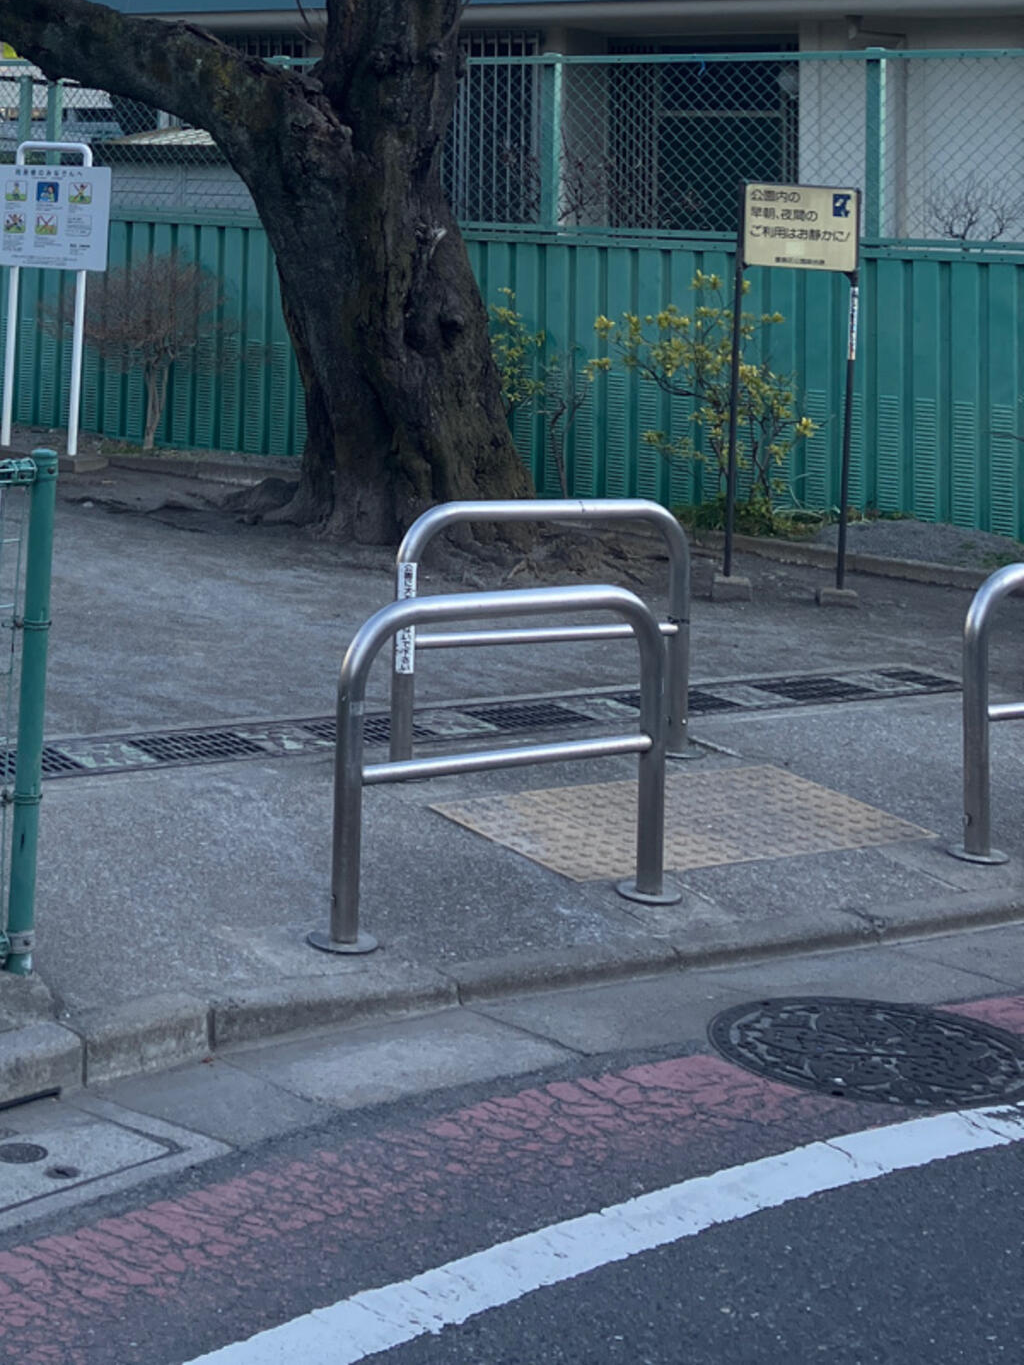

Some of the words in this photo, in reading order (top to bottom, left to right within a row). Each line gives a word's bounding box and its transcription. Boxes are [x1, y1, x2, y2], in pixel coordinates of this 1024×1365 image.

[750, 189, 800, 203] 公園内の
[750, 207, 818, 222] 早朝、夜間の
